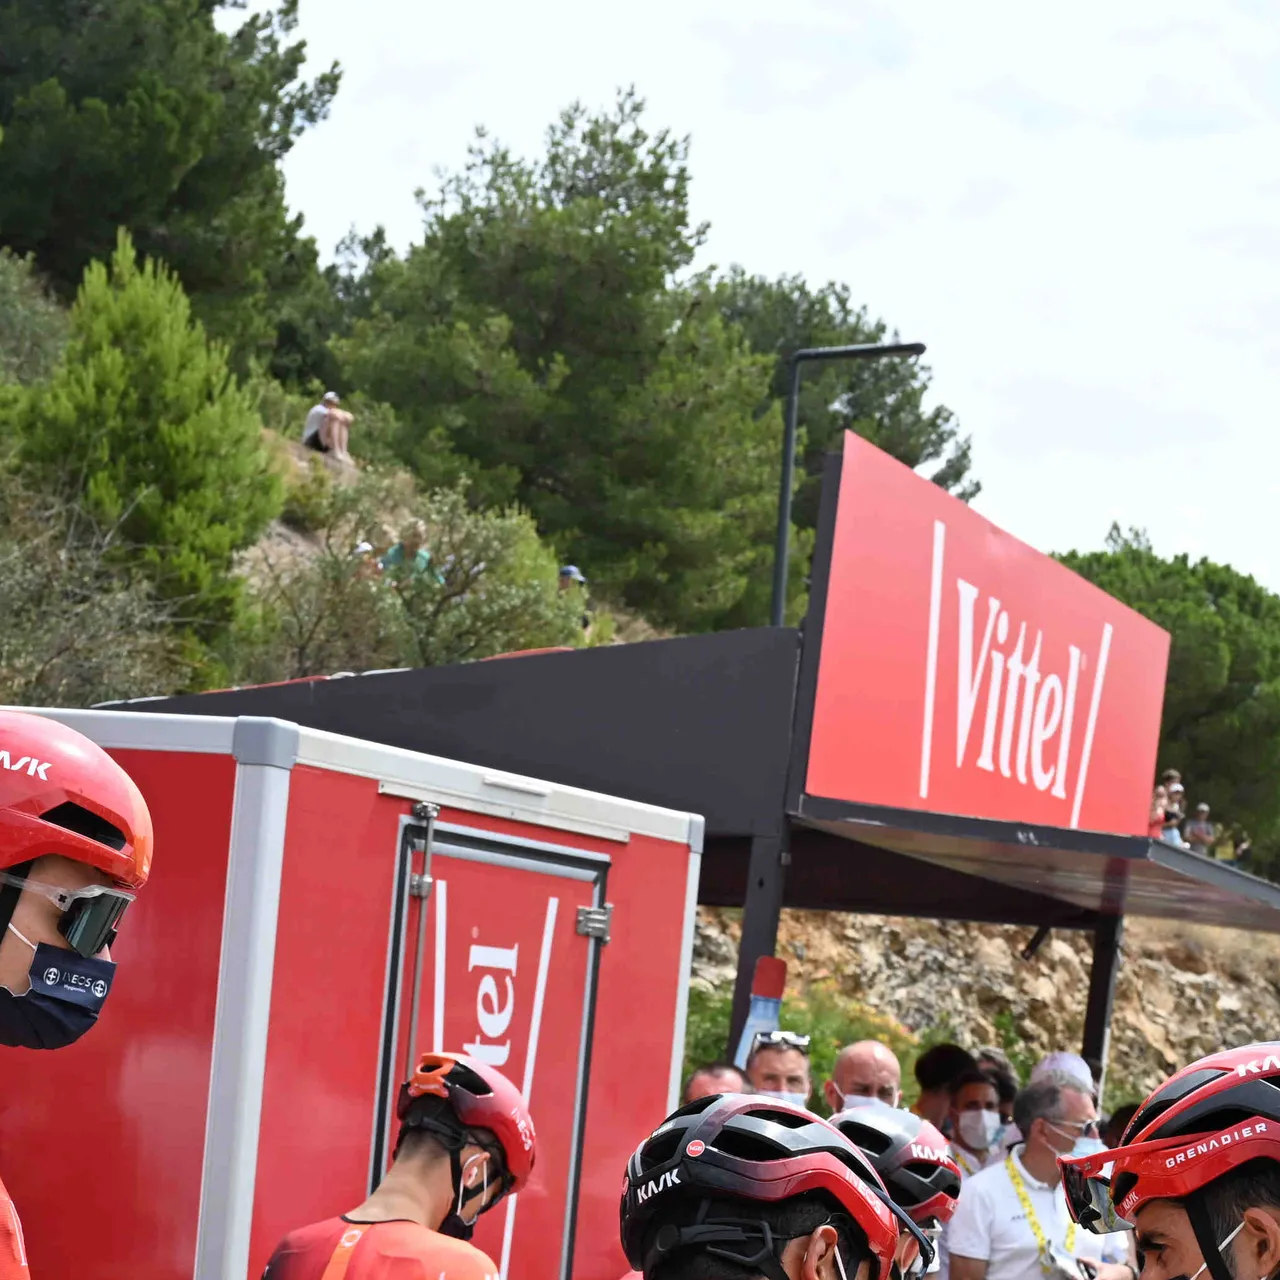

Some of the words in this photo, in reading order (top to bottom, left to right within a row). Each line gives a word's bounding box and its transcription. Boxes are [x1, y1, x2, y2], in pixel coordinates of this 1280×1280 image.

[957, 578, 1080, 799] Vittel
[462, 942, 519, 1066] tel
[1166, 1123, 1267, 1168] GRENADIER
[637, 1168, 681, 1203] KASK
[846, 1172, 881, 1215] INEOS
